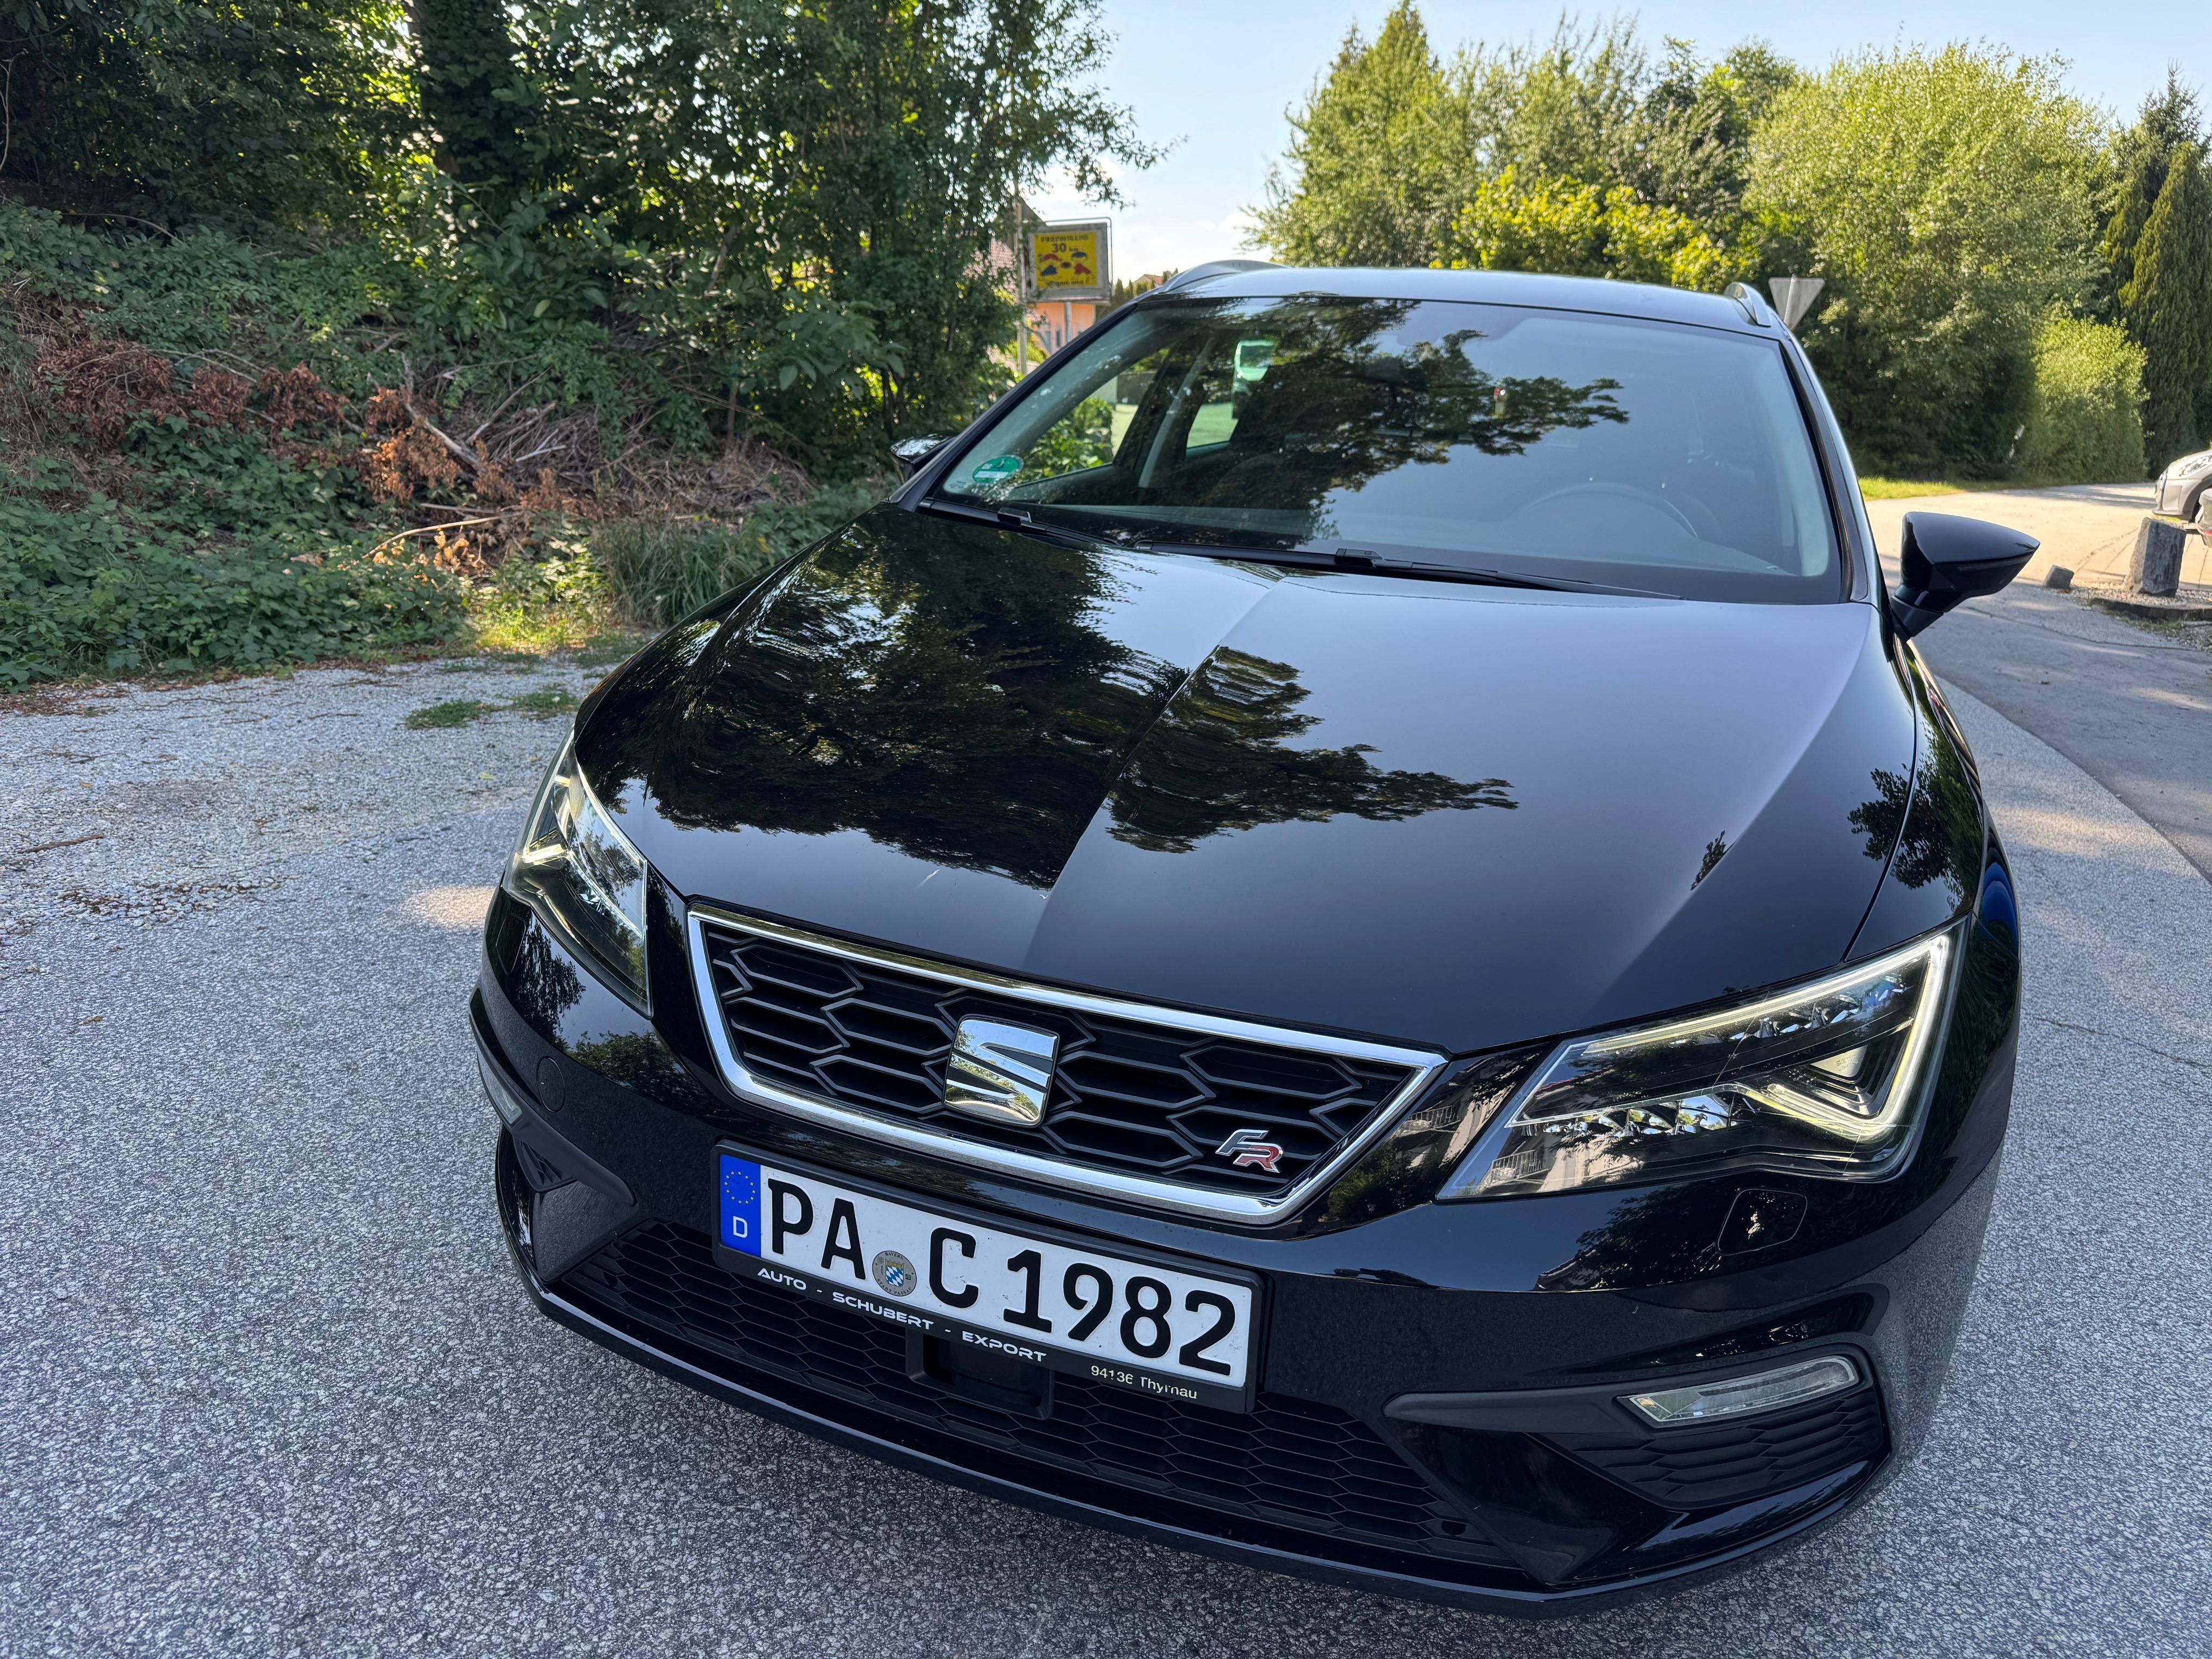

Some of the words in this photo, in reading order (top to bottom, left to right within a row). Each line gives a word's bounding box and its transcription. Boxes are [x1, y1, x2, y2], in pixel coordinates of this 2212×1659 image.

[1051, 243, 1067, 253] 30
[1215, 1129, 1284, 1174] FR
[733, 1216, 748, 1238] D
[767, 1178, 867, 1280] PA
[928, 1227, 979, 1309] C
[1003, 1249, 1236, 1377] 1982
[877, 1278, 892, 1292] STADT
[894, 1286, 912, 1295] PASSAU
[757, 1267, 807, 1291] AUTO
[832, 1292, 934, 1330] SCHUBERT
[962, 1330, 1047, 1363] EXPORT
